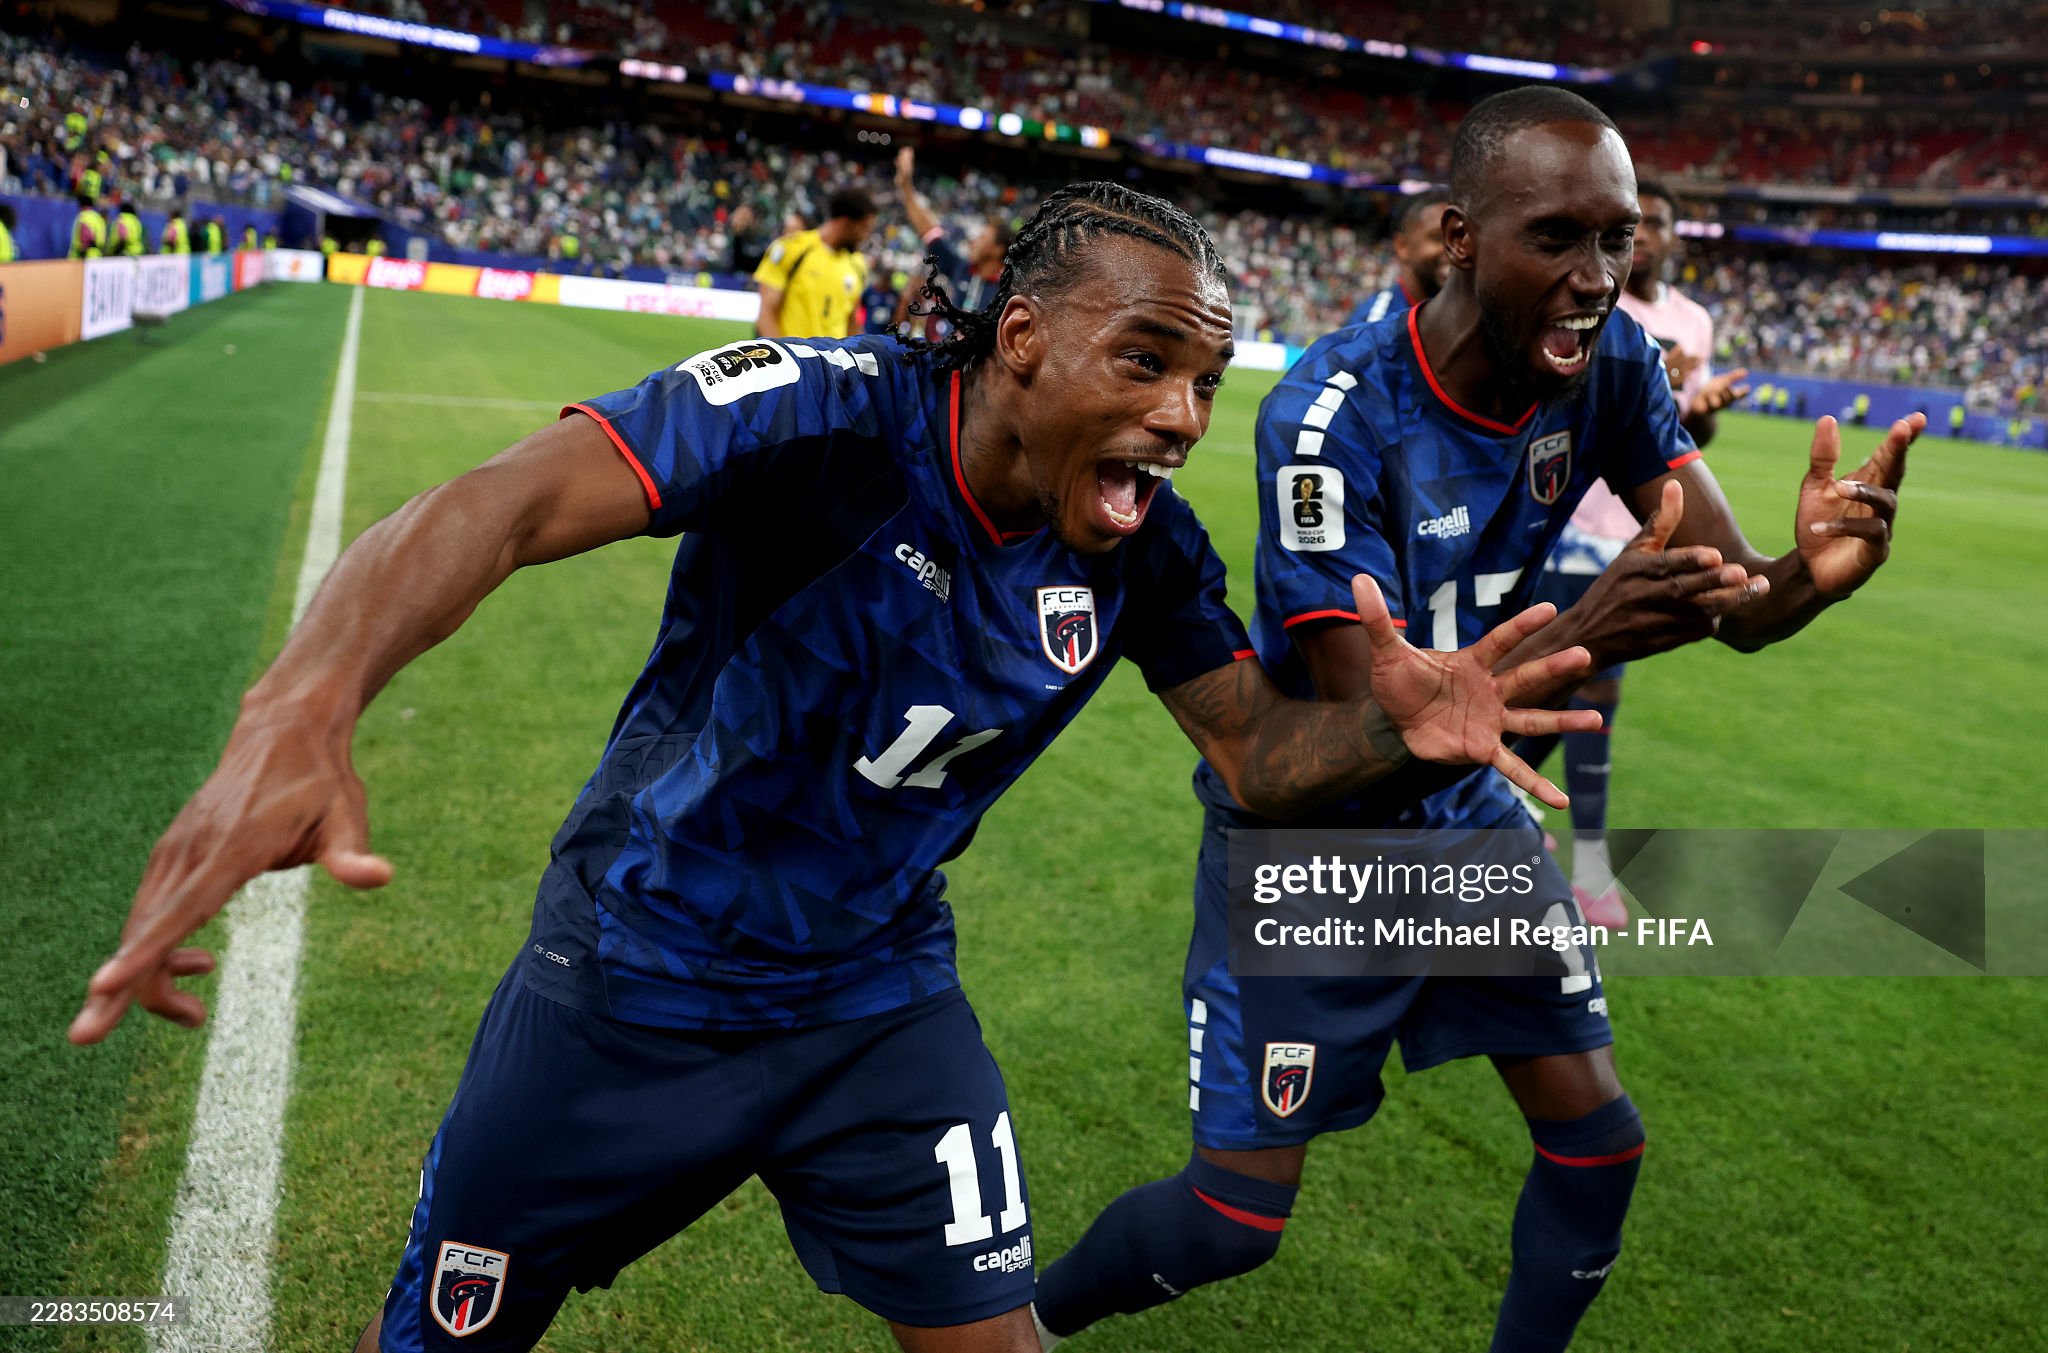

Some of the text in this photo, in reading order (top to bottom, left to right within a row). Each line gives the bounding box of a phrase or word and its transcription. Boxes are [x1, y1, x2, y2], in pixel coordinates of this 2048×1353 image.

[712, 370, 724, 382] CUP
[1534, 435, 1569, 457] FCF
[1418, 505, 1470, 539] capelli
[1297, 536, 1326, 544] 2026
[894, 543, 951, 597] capelli
[923, 579, 948, 604] SPORT
[1043, 591, 1089, 606] FCF
[852, 704, 1004, 790] 11
[1270, 1047, 1311, 1058] FCF
[934, 1111, 1027, 1247] 11
[444, 1248, 502, 1268] FCF
[973, 1235, 1032, 1273] capelli
[1007, 1257, 1032, 1273] SPORT
